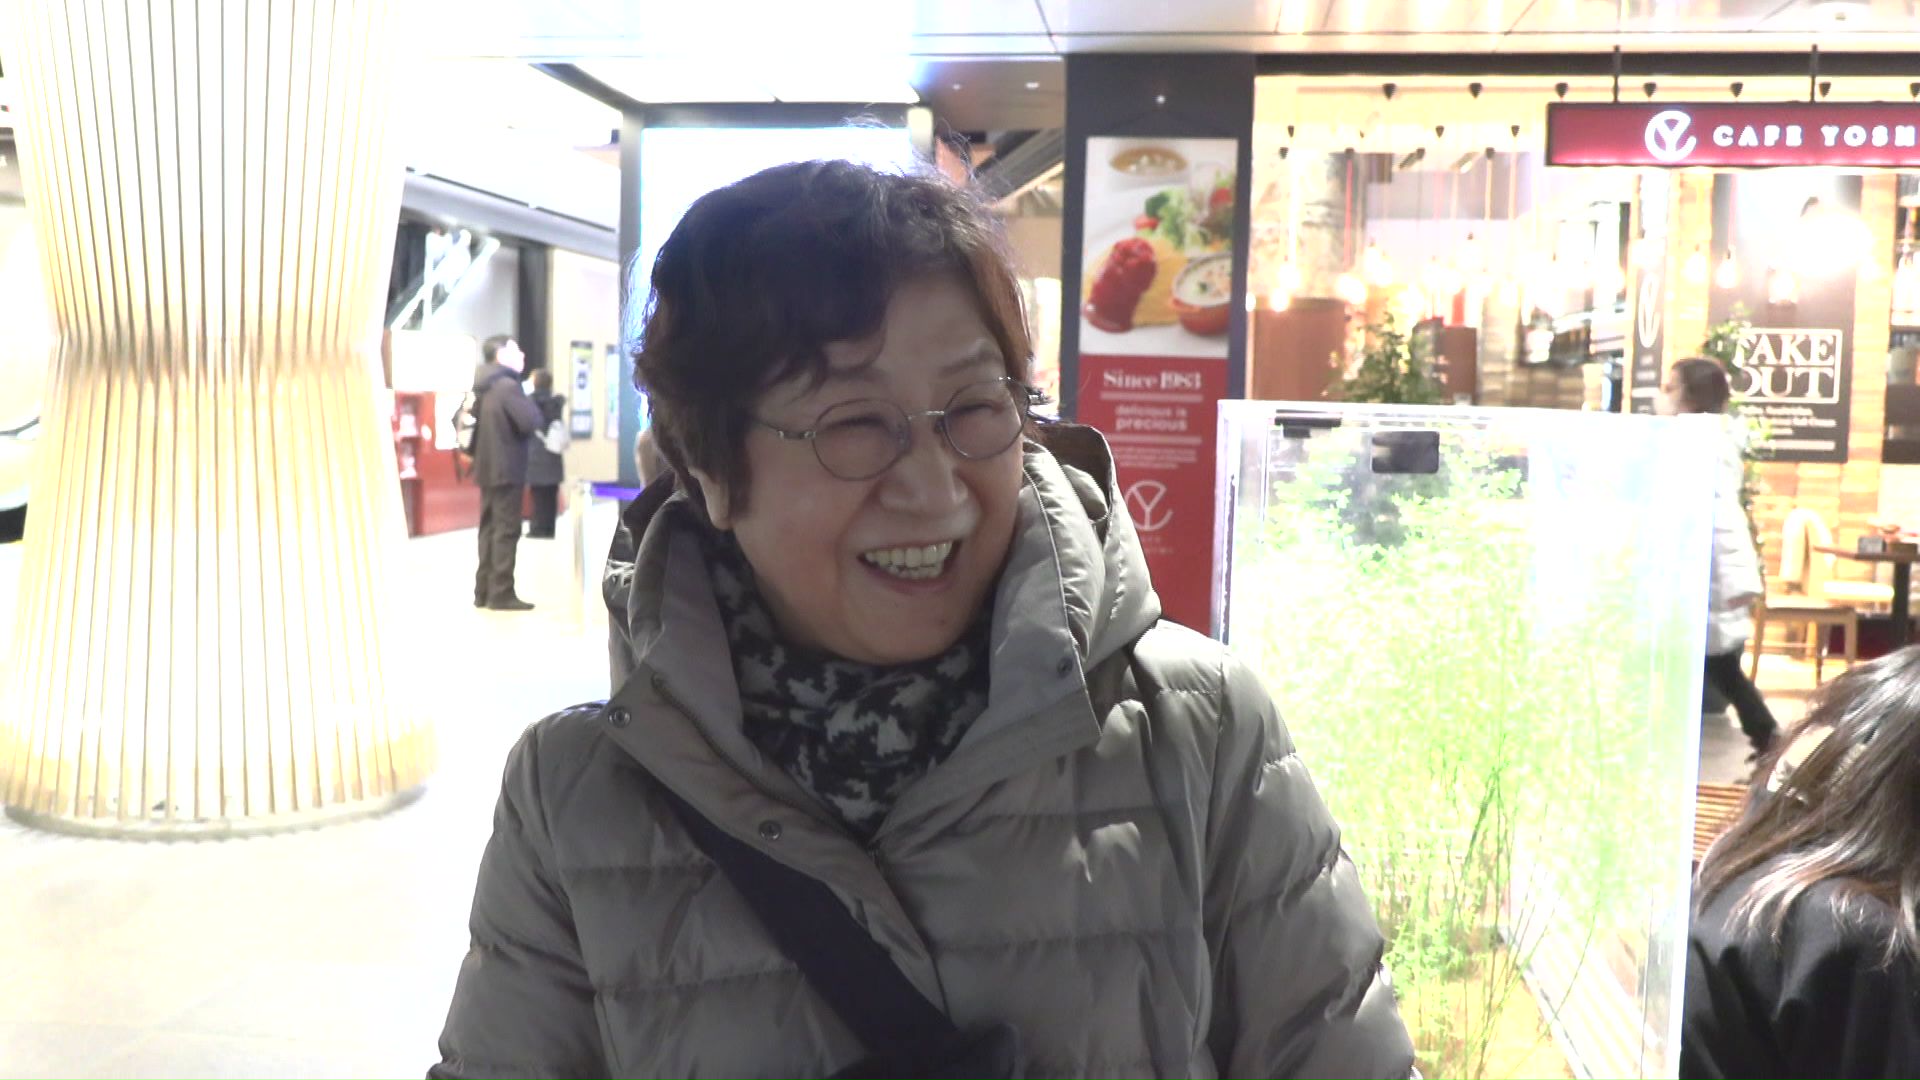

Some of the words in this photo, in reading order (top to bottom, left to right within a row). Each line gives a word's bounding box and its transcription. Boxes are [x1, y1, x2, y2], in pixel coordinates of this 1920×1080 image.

[1712, 124, 1803, 147] CAFE
[1103, 369, 1159, 389] Since
[1114, 418, 1188, 432] precious
